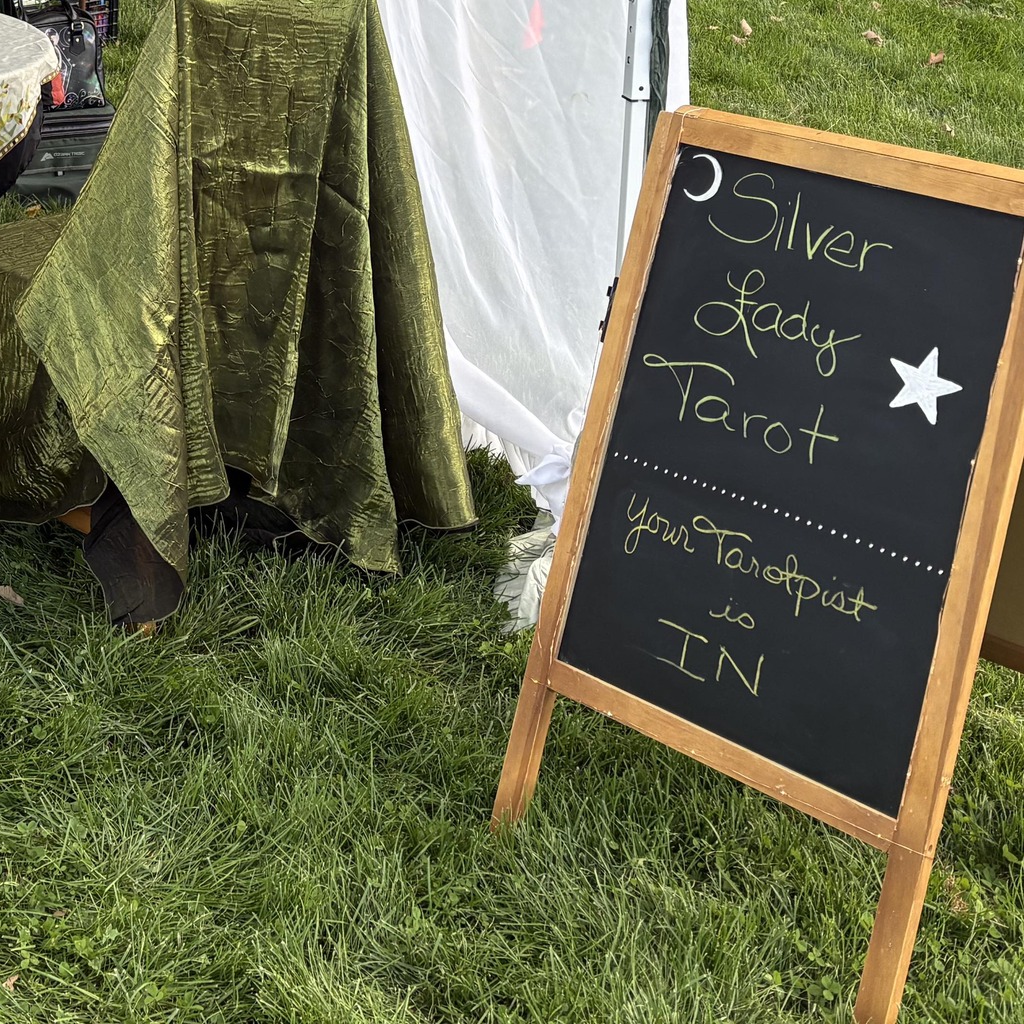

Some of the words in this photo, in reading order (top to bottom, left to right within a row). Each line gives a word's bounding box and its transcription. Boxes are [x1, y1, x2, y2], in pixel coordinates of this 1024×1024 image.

[707, 171, 894, 273] Silver
[693, 268, 863, 378] Lady
[642, 352, 840, 465] Tarot
[691, 514, 879, 623] Tarotpist
[708, 596, 756, 630] is
[655, 617, 765, 698] IN
